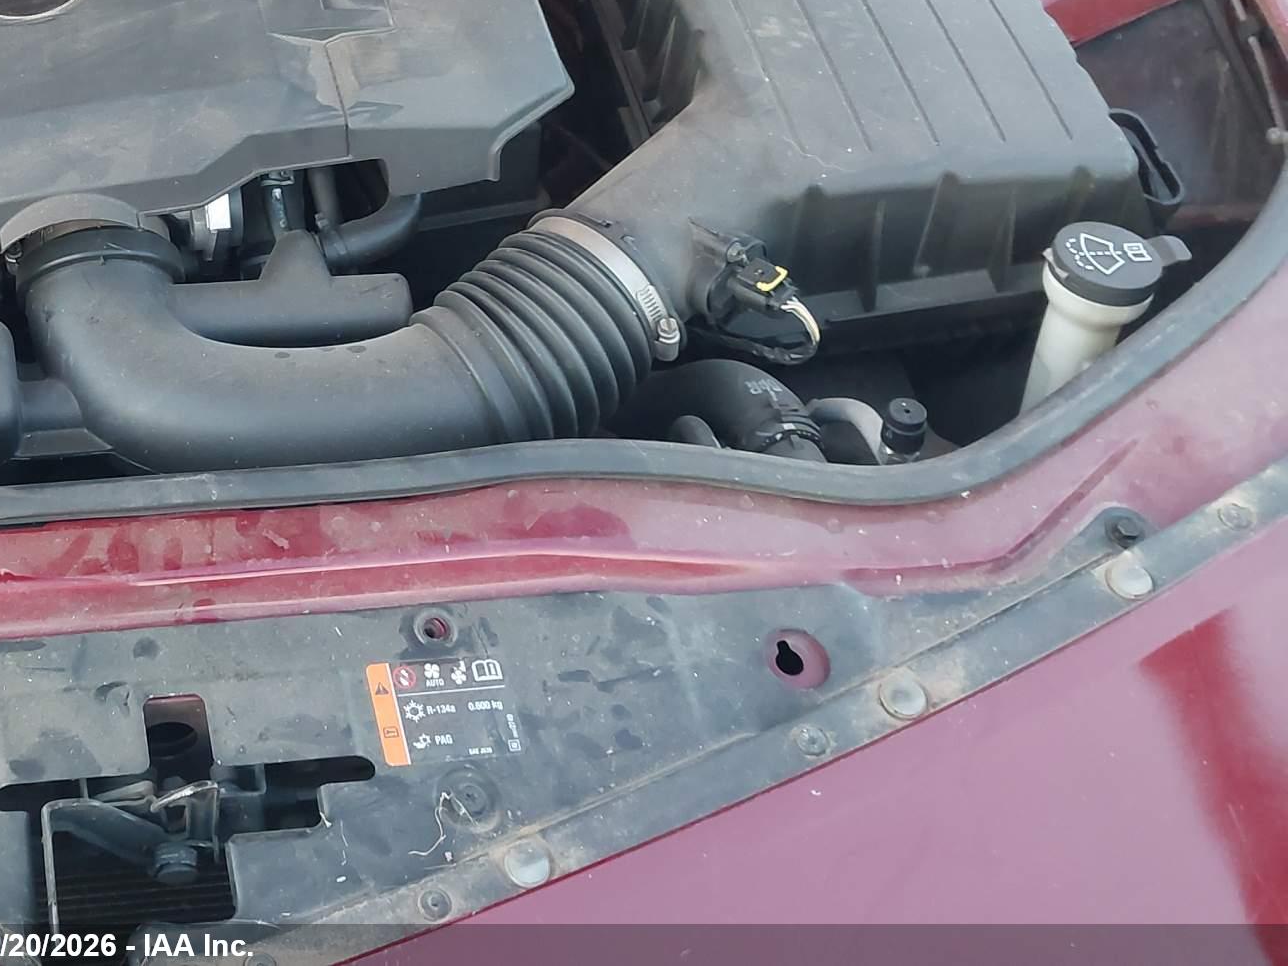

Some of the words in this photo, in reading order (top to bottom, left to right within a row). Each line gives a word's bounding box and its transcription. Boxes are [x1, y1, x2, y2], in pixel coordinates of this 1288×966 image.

[426, 678, 444, 687] AUTO
[426, 704, 456, 715] R-134a
[435, 734, 453, 745] PAG
